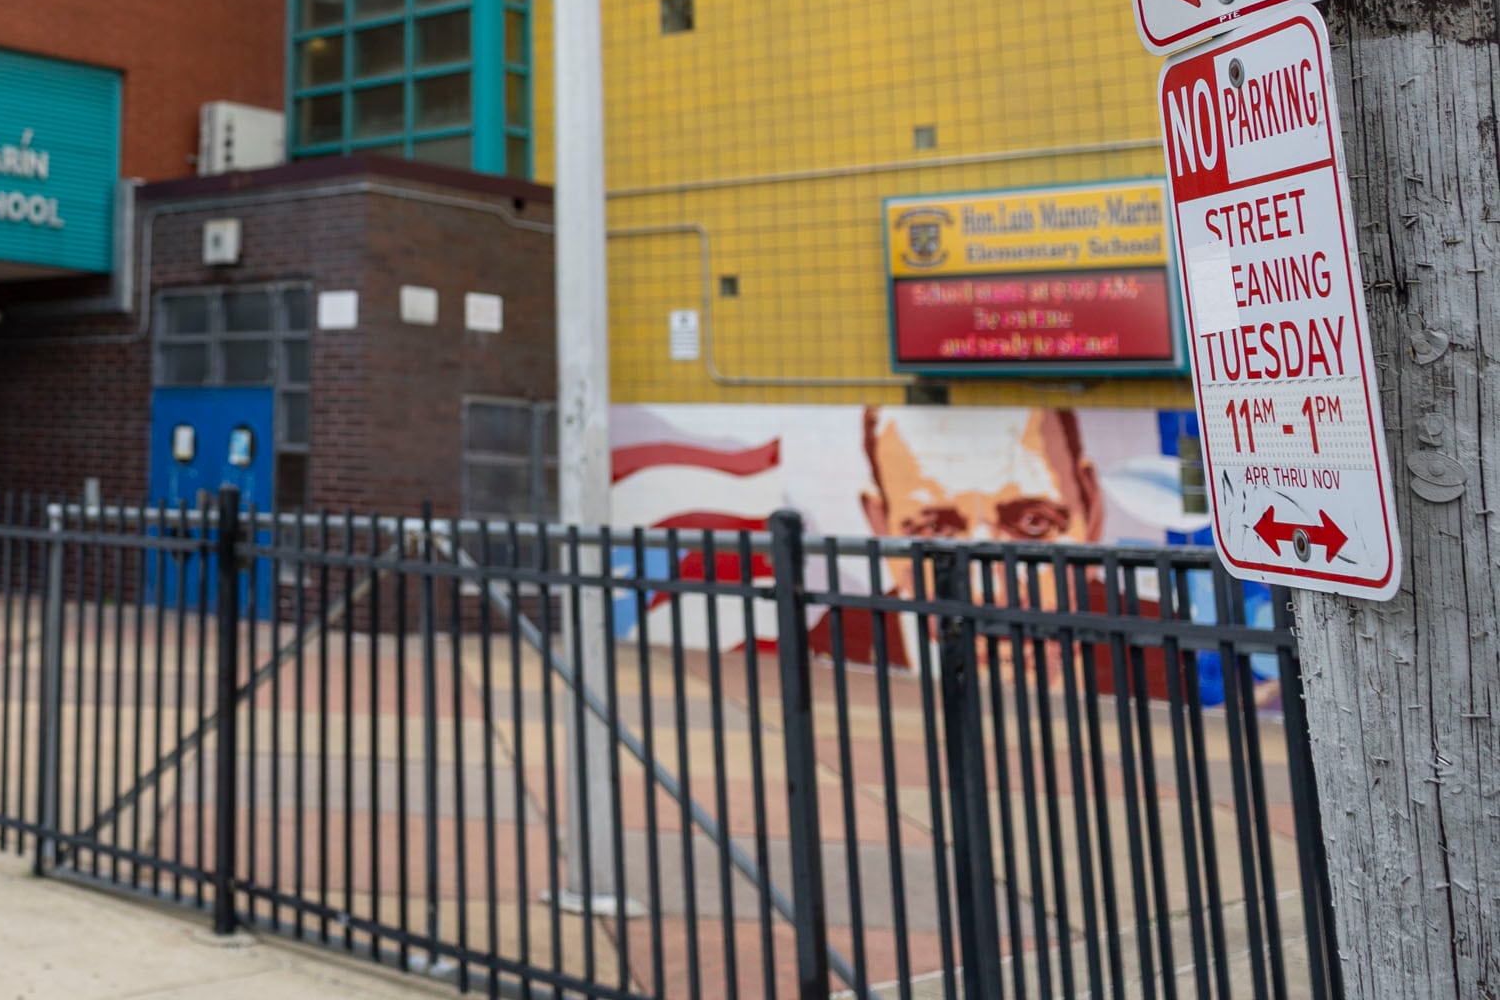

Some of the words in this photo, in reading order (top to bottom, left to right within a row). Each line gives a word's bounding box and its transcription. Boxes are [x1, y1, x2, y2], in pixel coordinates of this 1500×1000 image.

[1167, 78, 1218, 177] NO
[1223, 58, 1318, 148] PARKING
[1205, 189, 1306, 248] STREET
[966, 239, 1081, 264] Elementary
[1087, 232, 1161, 259] School
[1231, 251, 1332, 308] EANING
[1200, 316, 1345, 381] TUESDAY
[1245, 466, 1270, 486] APR
[1273, 467, 1308, 489] THRU
[1312, 470, 1340, 490] NOV
